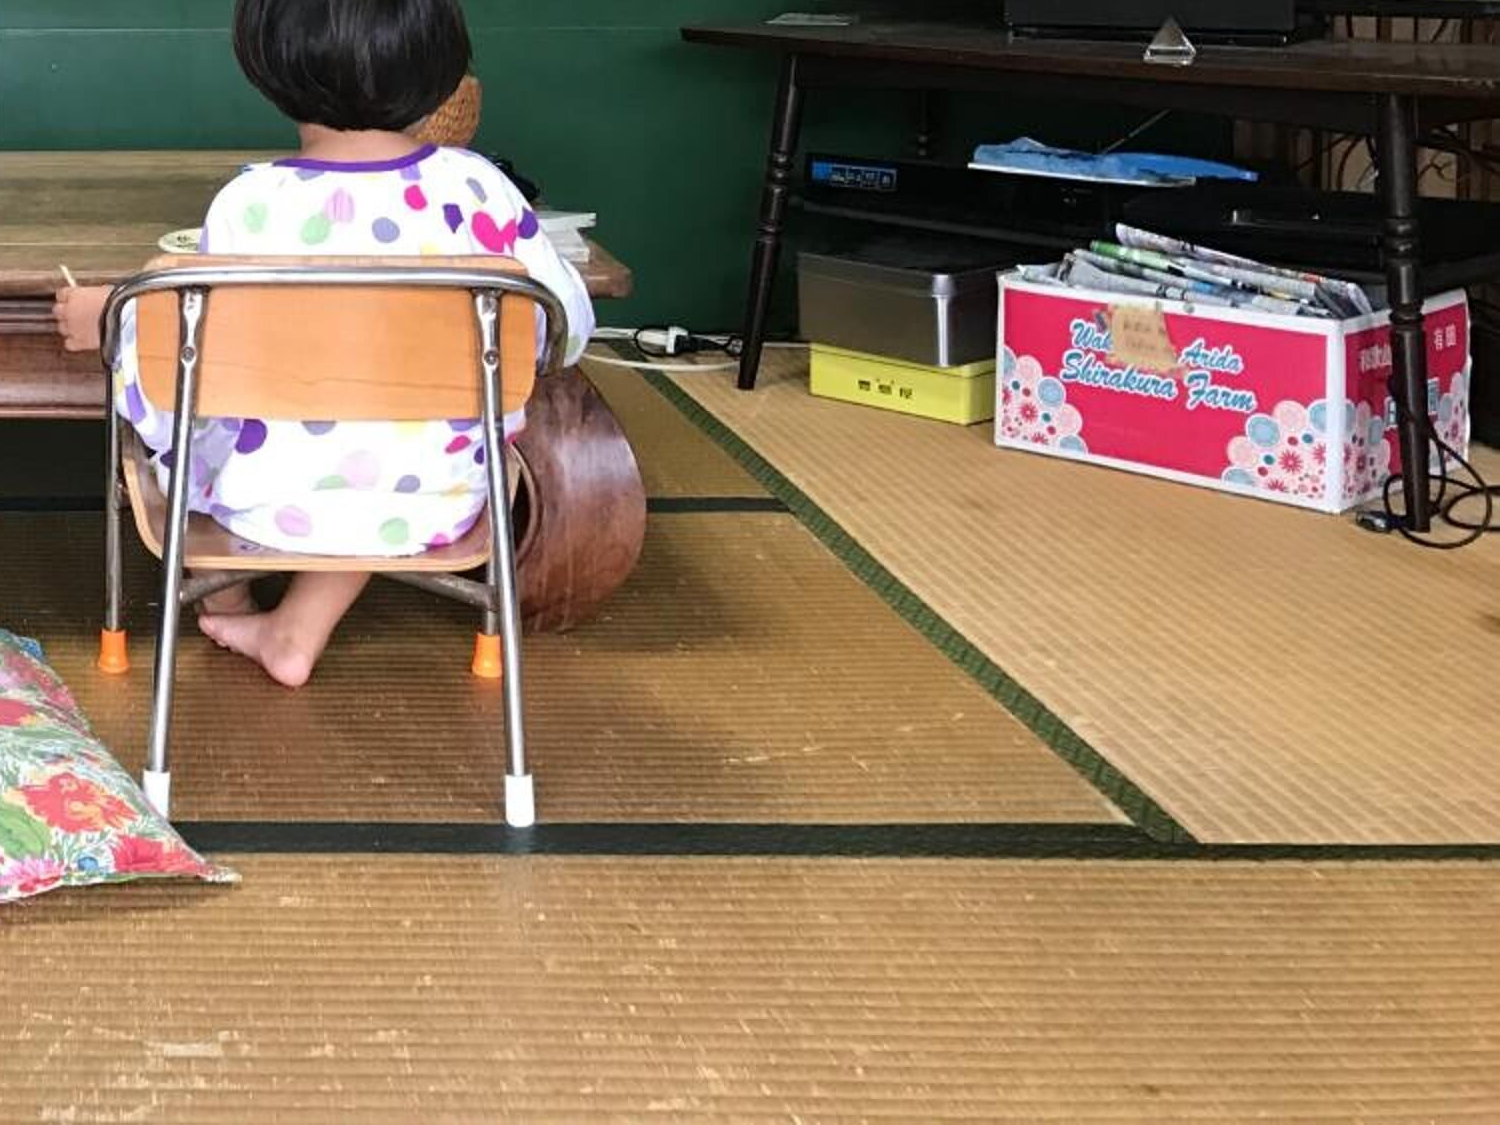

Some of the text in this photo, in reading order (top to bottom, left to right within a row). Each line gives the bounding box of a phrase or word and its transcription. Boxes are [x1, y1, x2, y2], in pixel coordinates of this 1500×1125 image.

[1179, 338, 1243, 373] Arida
[1061, 350, 1257, 411] Shirakura Farm
